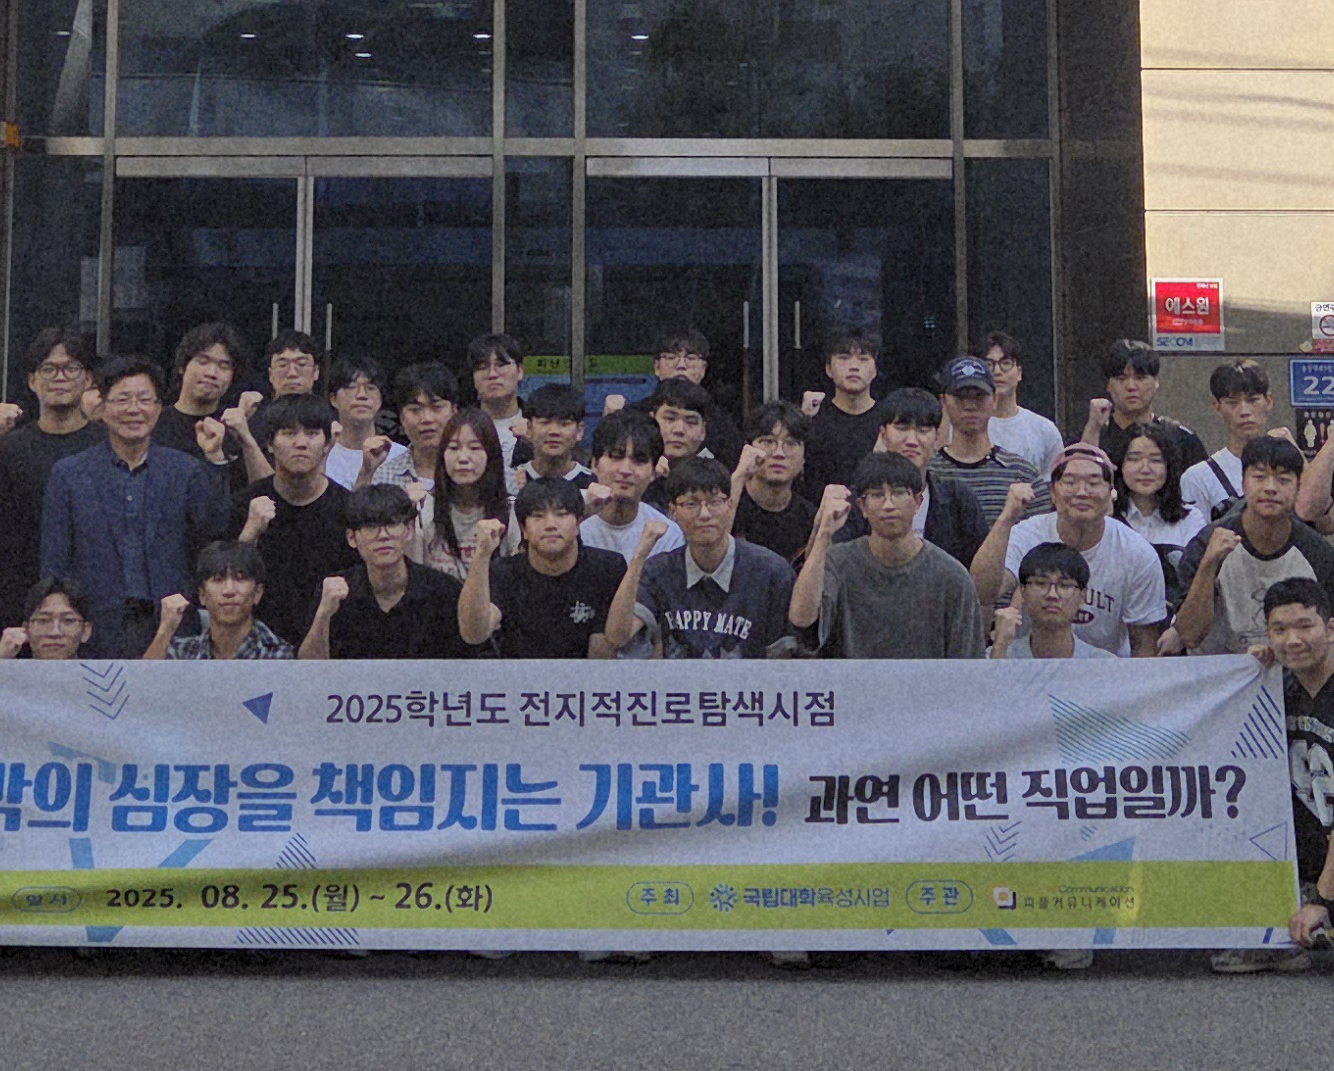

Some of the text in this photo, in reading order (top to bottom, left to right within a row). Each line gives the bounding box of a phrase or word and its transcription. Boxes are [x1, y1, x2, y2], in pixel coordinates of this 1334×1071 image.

[1165, 296, 1210, 315] 에스원
[1084, 588, 1115, 613] ULT
[325, 689, 836, 728] 2025학년도 전지적진로탐색시점
[109, 763, 297, 833] 심장을
[310, 763, 561, 831] 책임지는
[576, 762, 780, 831] 기관사!
[803, 772, 901, 825] 과연
[912, 770, 1010, 822] 어떤
[1021, 765, 1246, 819] 직업일까?
[106, 888, 182, 909] 2025.
[201, 885, 248, 909] 08.
[261, 884, 360, 912] 25.(월)
[395, 882, 493, 912] 26.(화)
